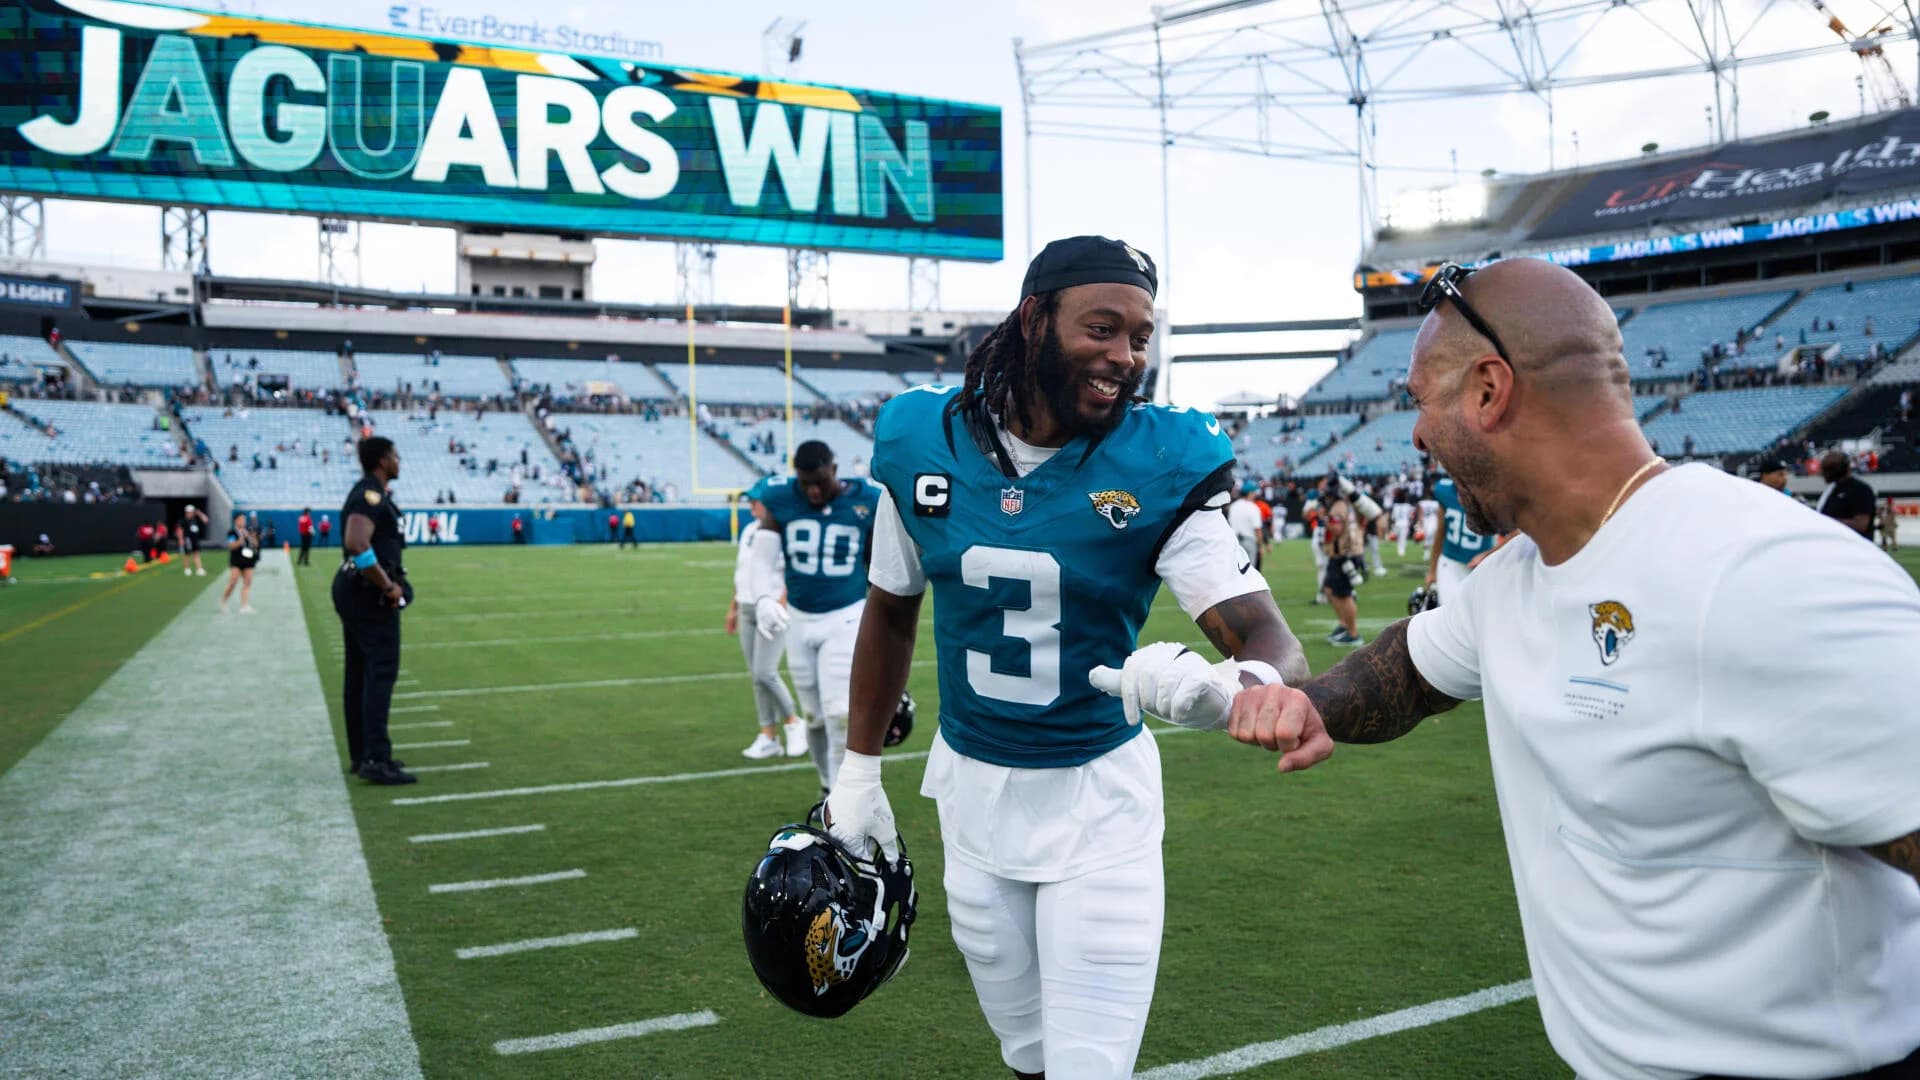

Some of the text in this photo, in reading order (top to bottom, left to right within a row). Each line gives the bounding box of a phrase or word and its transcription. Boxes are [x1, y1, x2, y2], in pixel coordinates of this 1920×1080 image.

[418, 7, 665, 58] EverBank Stadium
[17, 25, 936, 223] JAGUARS WIN
[1691, 136, 1920, 190] Health
[1608, 232, 1698, 261] JAGUAS
[1699, 226, 1745, 248] WIN
[1766, 207, 1868, 240] JAGUAS
[1872, 199, 1920, 224] WIN
[8, 283, 67, 304] LIGHT
[915, 474, 949, 507] C
[785, 518, 860, 577] 80
[961, 544, 1061, 706] 3
